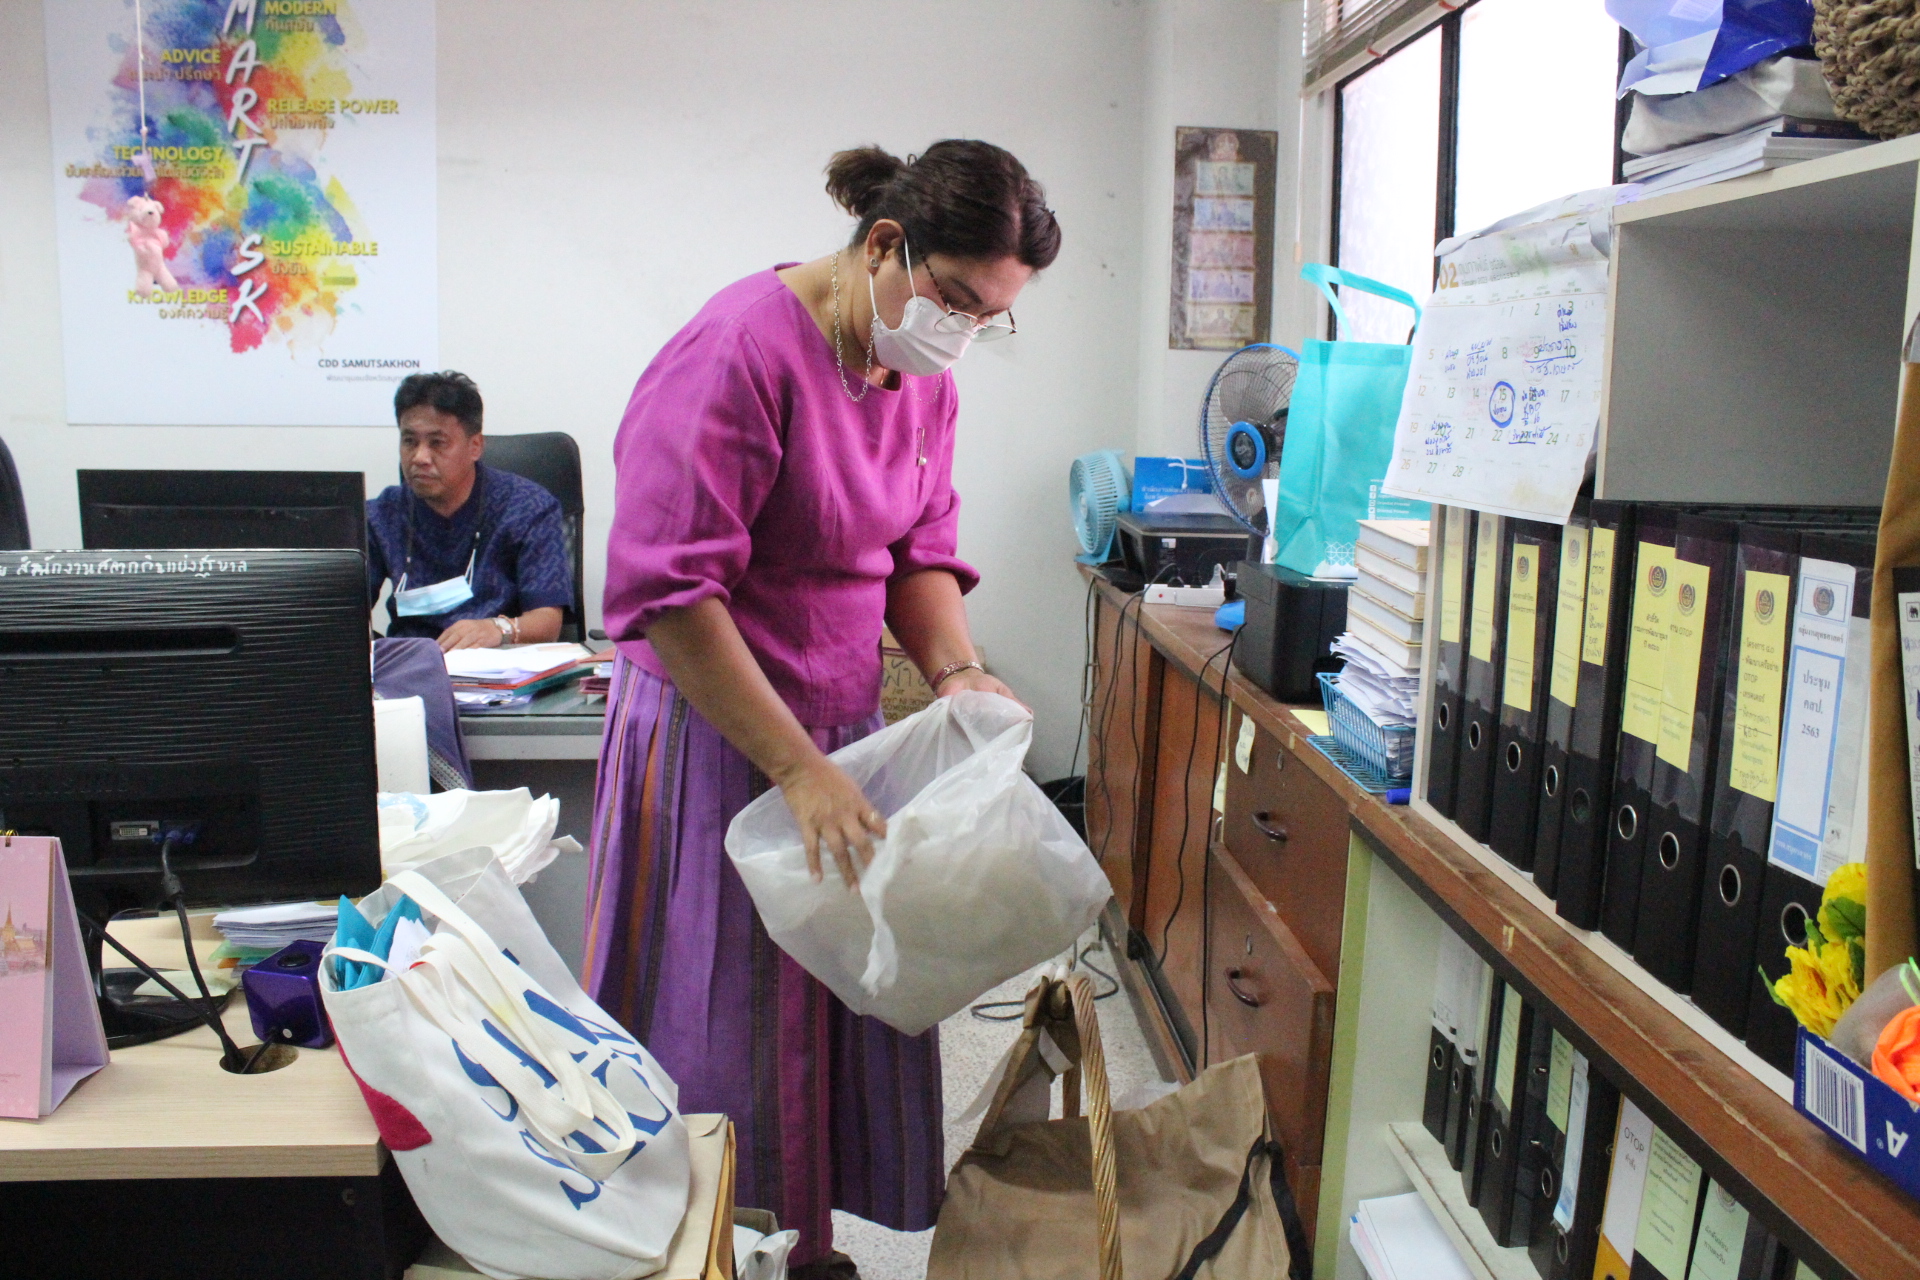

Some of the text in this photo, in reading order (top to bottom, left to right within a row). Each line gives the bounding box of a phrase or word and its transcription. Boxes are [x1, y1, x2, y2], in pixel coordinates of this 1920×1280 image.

[265, 2, 337, 15] MODERN
[161, 50, 221, 64] ADVICE
[268, 99, 398, 114] RELEASE POWER
[272, 241, 378, 256] SUSTAINABLE
[1439, 261, 1459, 290] 02
[1534, 303, 1540, 316] 2
[1428, 349, 1435, 360] 5
[1502, 347, 1508, 359] 8
[317, 358, 420, 369] CDD SAMUTSAKHON
[1418, 386, 1427, 398] 12
[1447, 387, 1456, 398] 13
[1473, 387, 1480, 398] 14
[1500, 388, 1507, 401] 15
[1561, 389, 1570, 402] 17
[1410, 422, 1418, 433] 19
[1466, 427, 1475, 439] 21
[1492, 430, 1503, 442] 22
[1545, 432, 1559, 445] 24
[1401, 459, 1411, 470] 26
[1427, 462, 1437, 474] 27
[1452, 465, 1464, 477] 28
[1803, 669, 1831, 692] ประชุม
[1801, 723, 1820, 739] 2563
[1623, 1126, 1645, 1153] OTOP
